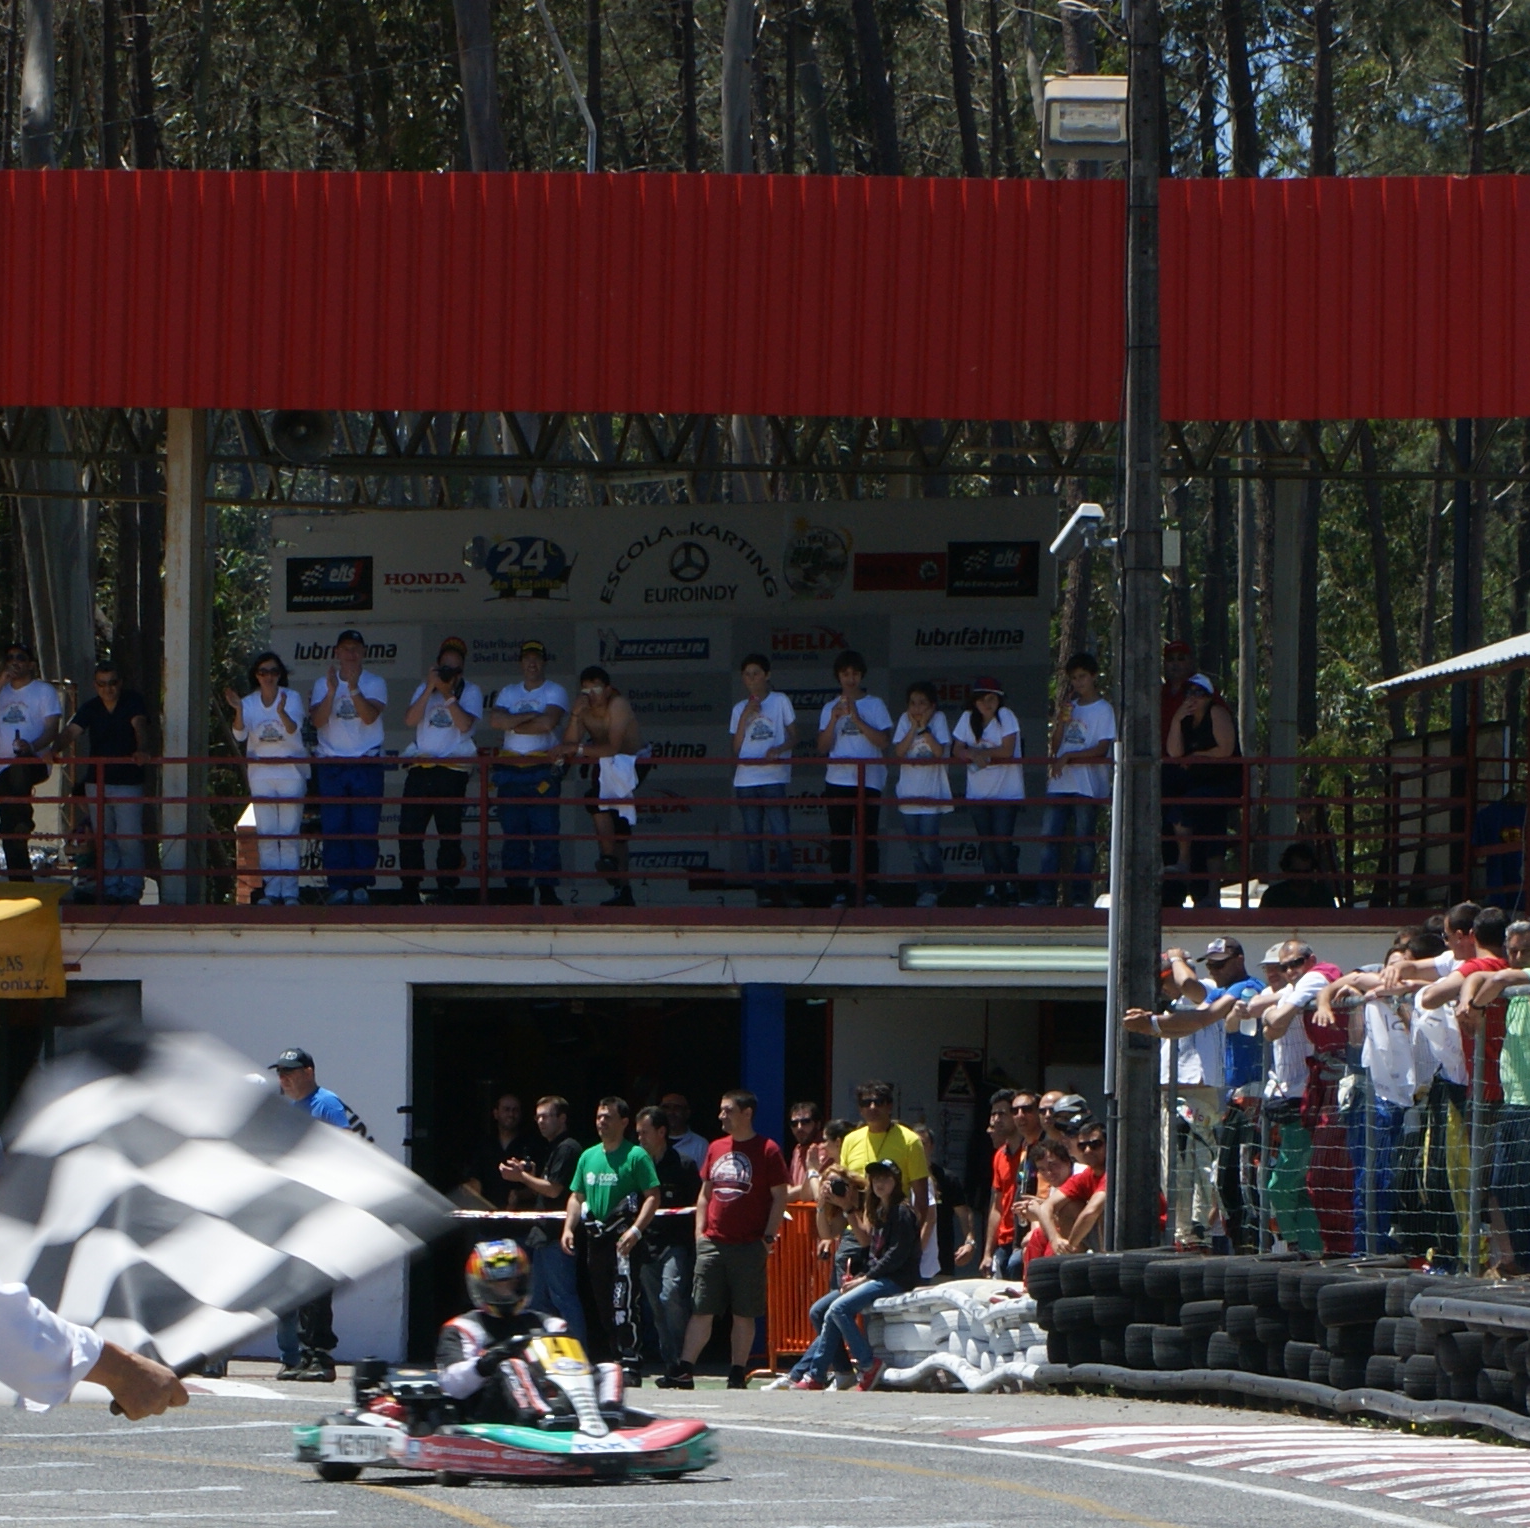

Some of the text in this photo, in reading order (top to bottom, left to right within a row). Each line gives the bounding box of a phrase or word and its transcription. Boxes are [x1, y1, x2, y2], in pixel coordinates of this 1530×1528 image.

[496, 540, 548, 574] 24
[600, 525, 673, 605] ESCOLA
[690, 521, 778, 598] KARTING
[384, 572, 466, 585] HONDA
[292, 594, 355, 604] Motorsport
[644, 584, 739, 603] EUROINDY
[621, 641, 706, 656] MICHELIN
[772, 633, 845, 650] HELIX
